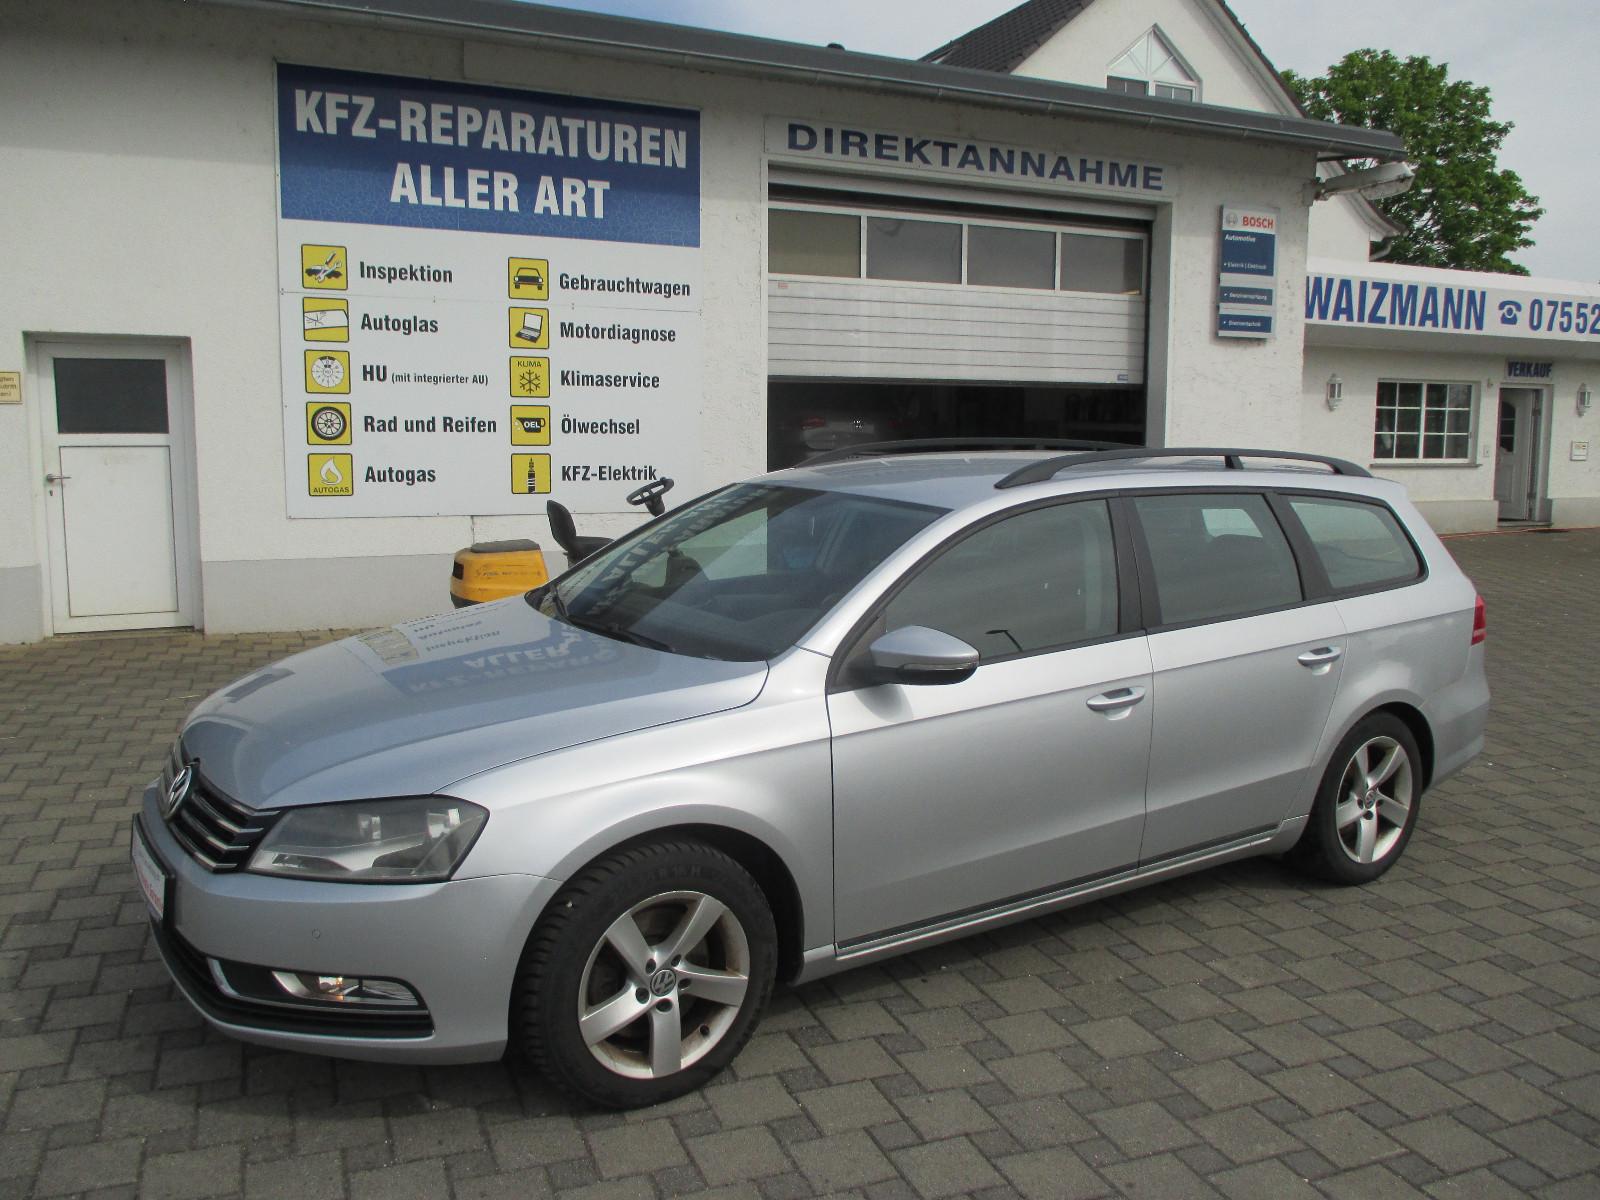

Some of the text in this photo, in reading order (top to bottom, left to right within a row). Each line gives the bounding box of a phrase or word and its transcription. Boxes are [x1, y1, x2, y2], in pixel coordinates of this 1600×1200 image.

[294, 88, 687, 169] KFZ-REPARATUREN
[787, 122, 1164, 191] DIREKTANNAHME
[390, 162, 611, 220] ALLER ART
[1242, 215, 1274, 230] BOSCH
[360, 261, 453, 285] Inspektion
[559, 273, 691, 300] Gebrauchtwagen
[1305, 276, 1486, 331] WAIZMANN
[361, 313, 439, 335] Autoglas
[1529, 298, 1600, 334] 07552
[560, 321, 676, 343] Motordiagnose
[361, 364, 490, 388] HU (mit integrierter AU)
[560, 369, 660, 388] Klimaservice
[1507, 361, 1553, 378] VERKAUF
[363, 415, 497, 434] Rad und Reifen
[523, 421, 540, 429] OEL
[561, 414, 640, 434] Ölwechsel
[365, 465, 436, 485] Autogas
[562, 464, 657, 481] KFZ-Elektrik
[313, 485, 351, 495] AUTOGAS
